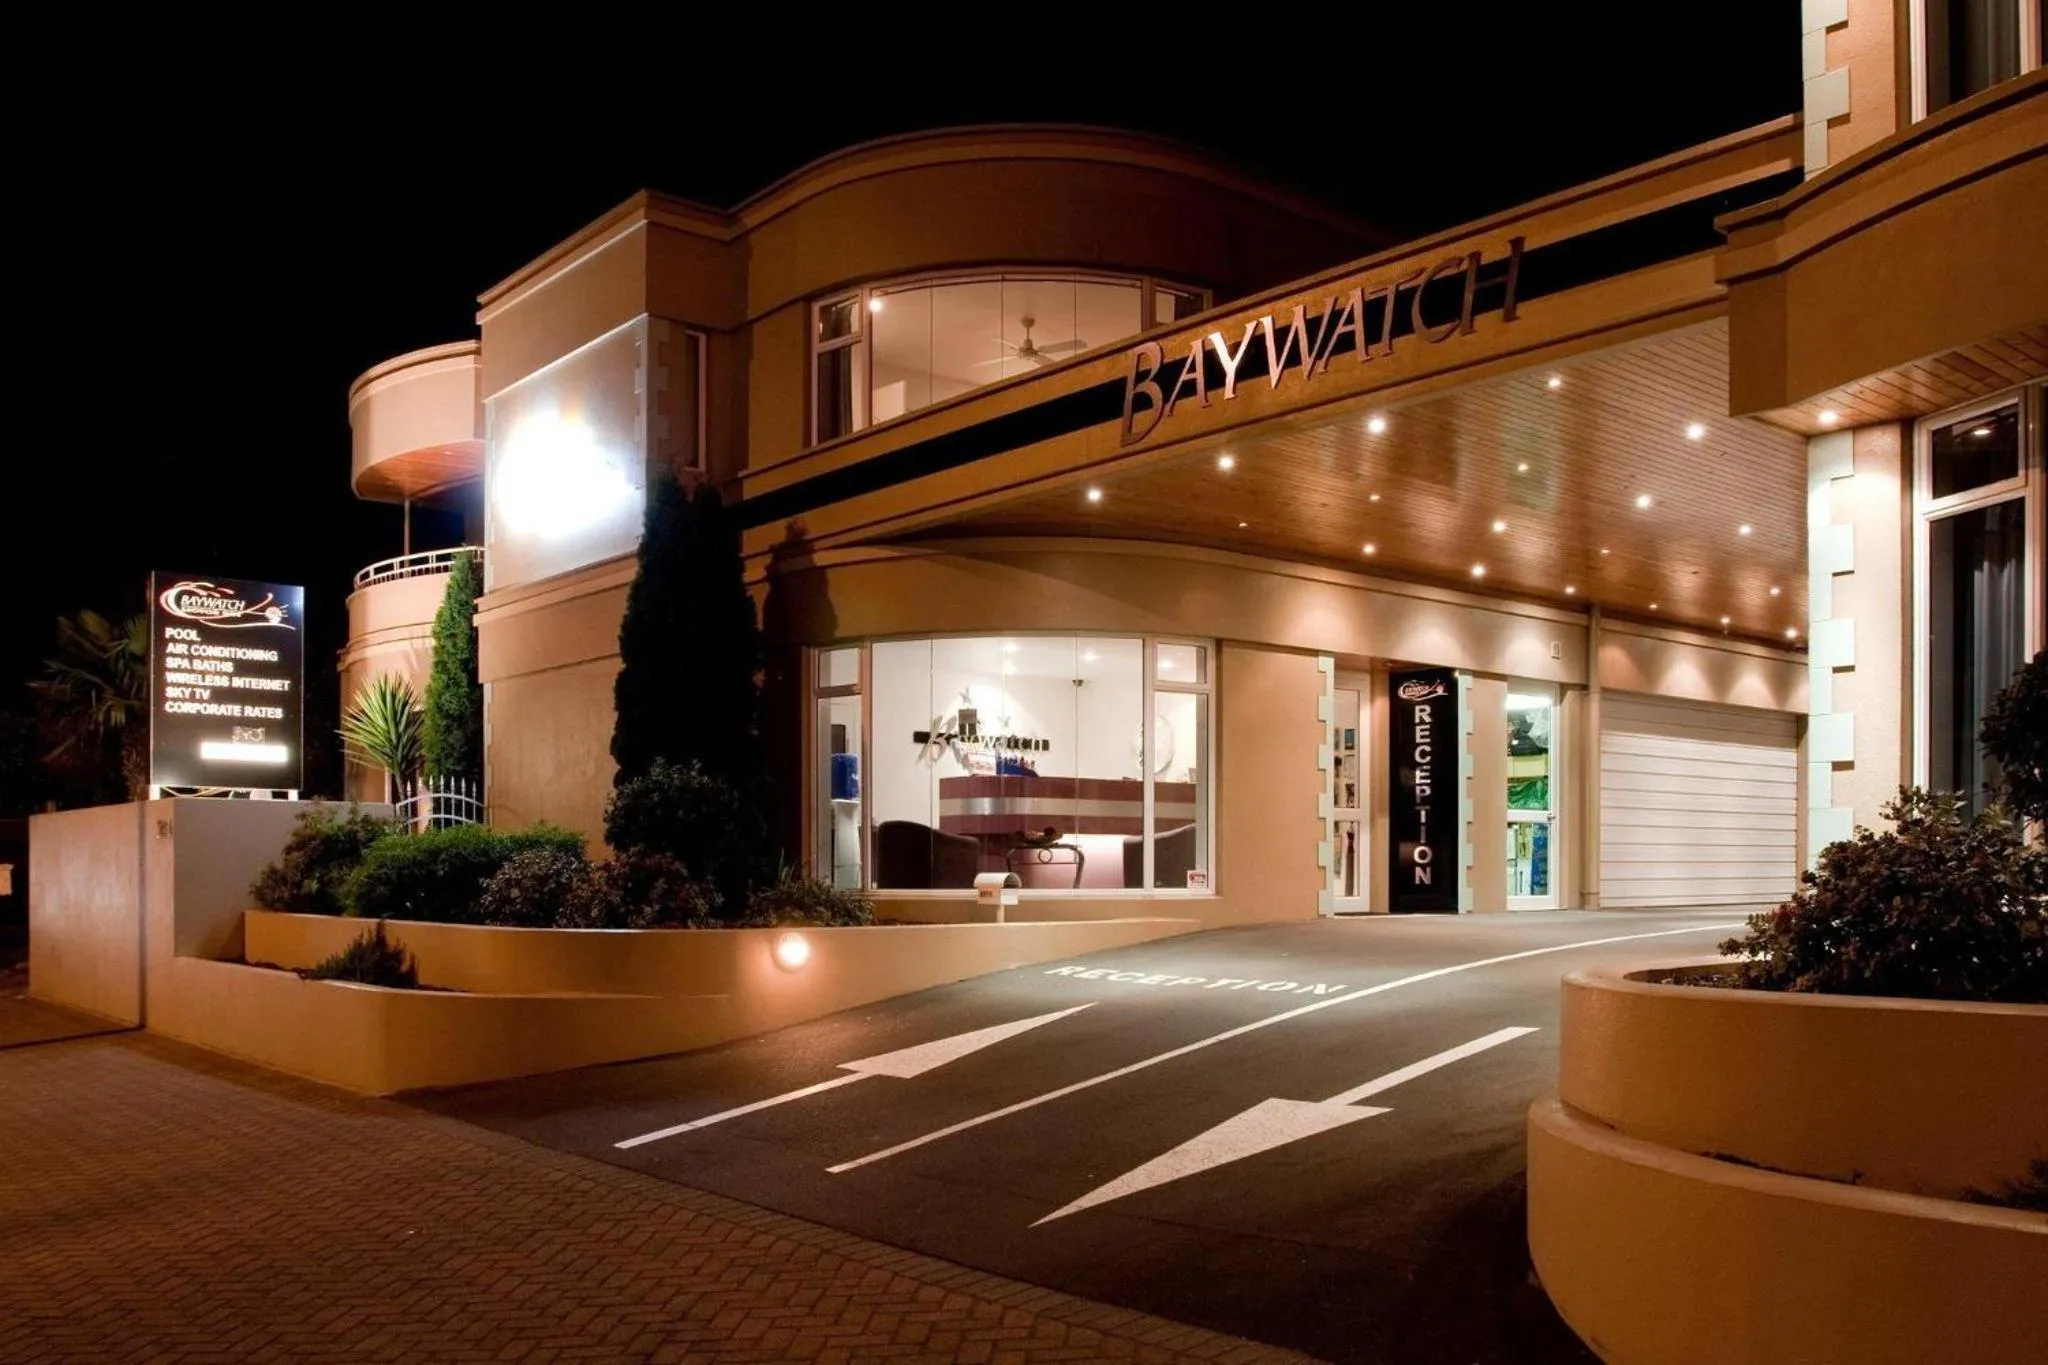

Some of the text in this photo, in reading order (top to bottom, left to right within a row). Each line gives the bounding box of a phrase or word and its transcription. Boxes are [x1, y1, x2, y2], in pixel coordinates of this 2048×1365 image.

[1120, 236, 1526, 447] BAYWATCH
[165, 627, 201, 641] POOL
[166, 642, 278, 661] AIR CONDITIONING
[165, 657, 234, 673] SPA BATHS
[166, 671, 291, 691] WIRELESS INTERNET
[165, 686, 211, 700] SKY TV
[165, 701, 283, 719] CORPORATE RATES
[1414, 704, 1432, 885] RECEPTION
[1043, 965, 1350, 995] RECEPTION
